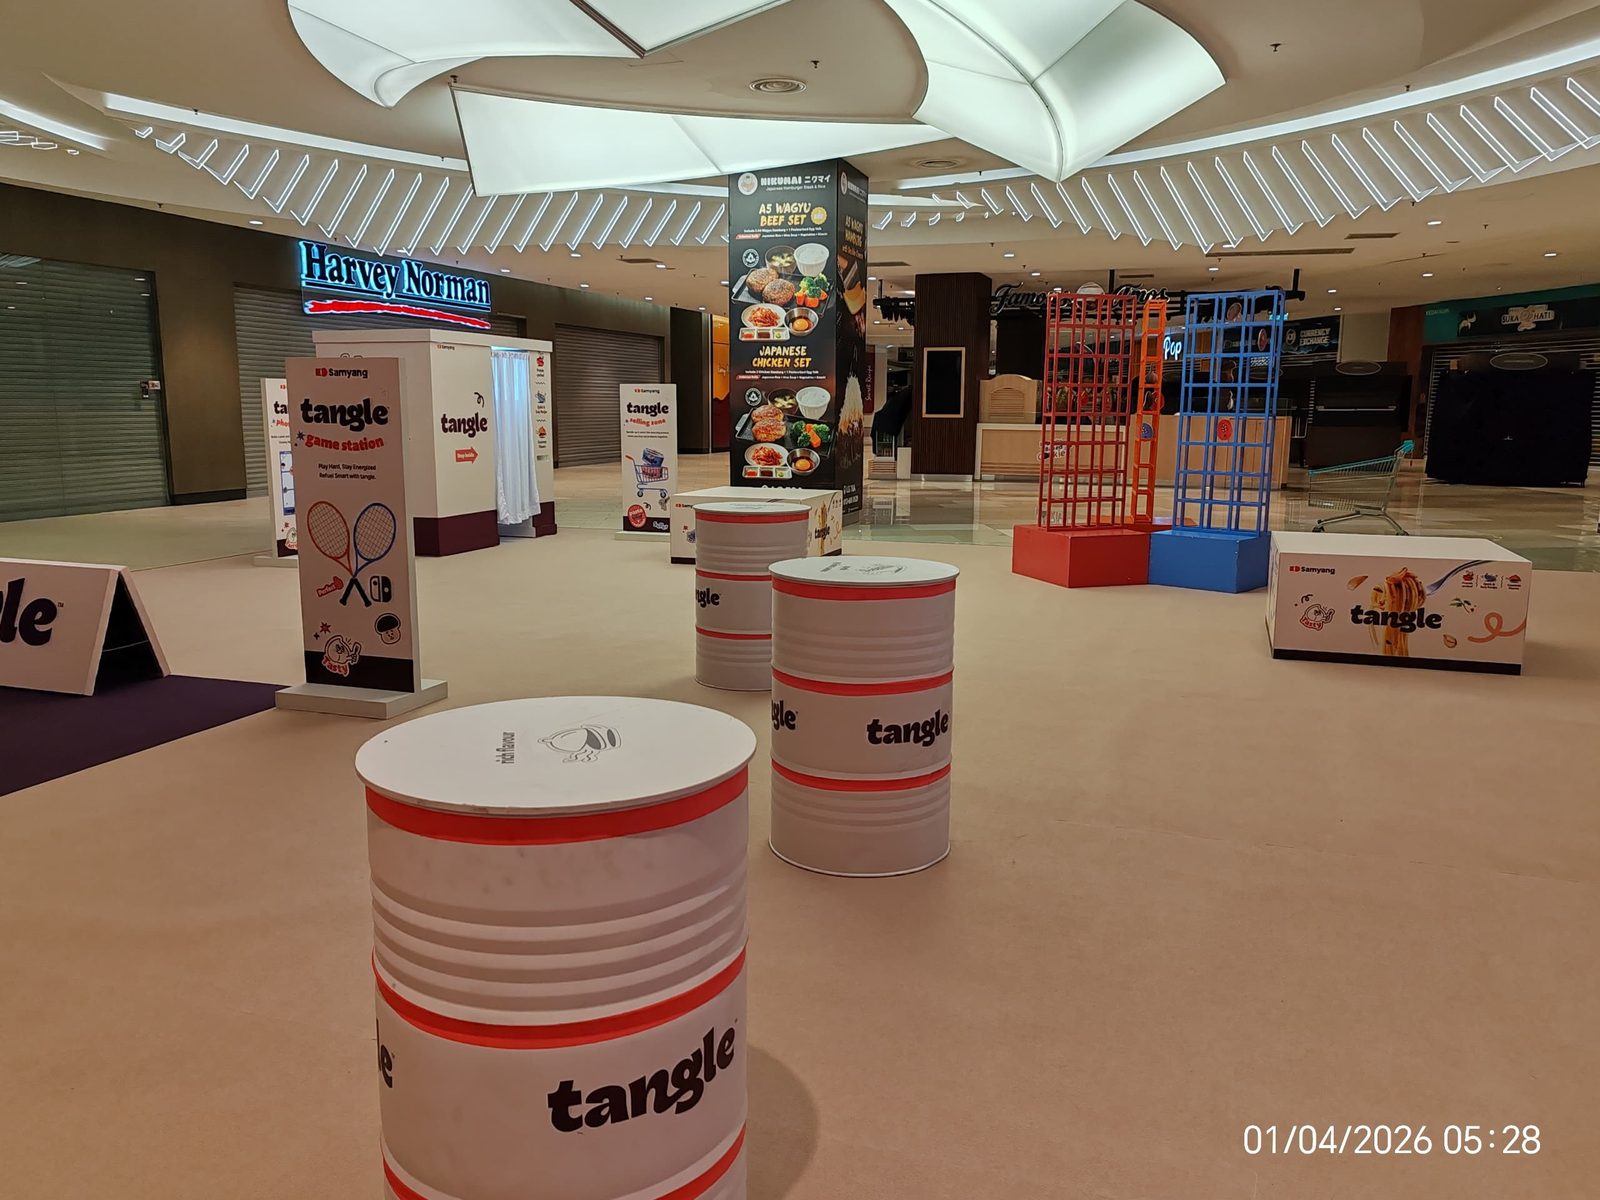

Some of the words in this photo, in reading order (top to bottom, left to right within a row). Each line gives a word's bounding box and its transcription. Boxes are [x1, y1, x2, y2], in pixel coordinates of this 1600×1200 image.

[759, 203, 773, 214] A5
[775, 202, 811, 214] WAGYU
[760, 215, 785, 226] BEEF
[787, 214, 807, 226] SET
[299, 241, 400, 298] Harvey
[402, 259, 491, 305] Norman
[759, 345, 807, 357] JAPANESE
[1163, 336, 1182, 360] Pop
[752, 358, 791, 368] CHICKEN
[793, 357, 812, 368] SET
[329, 368, 368, 378] Samyang
[301, 398, 389, 432] tangle
[626, 402, 669, 417] tangle
[441, 412, 488, 438] tangle
[305, 434, 340, 450] game
[341, 437, 385, 451] station
[1301, 566, 1336, 575] Samyang
[1300, 617, 1323, 631] Tasty
[1350, 605, 1443, 633] tangle
[322, 656, 349, 675] Tasty
[867, 709, 949, 747] tangle
[547, 1026, 735, 1133] tangle
